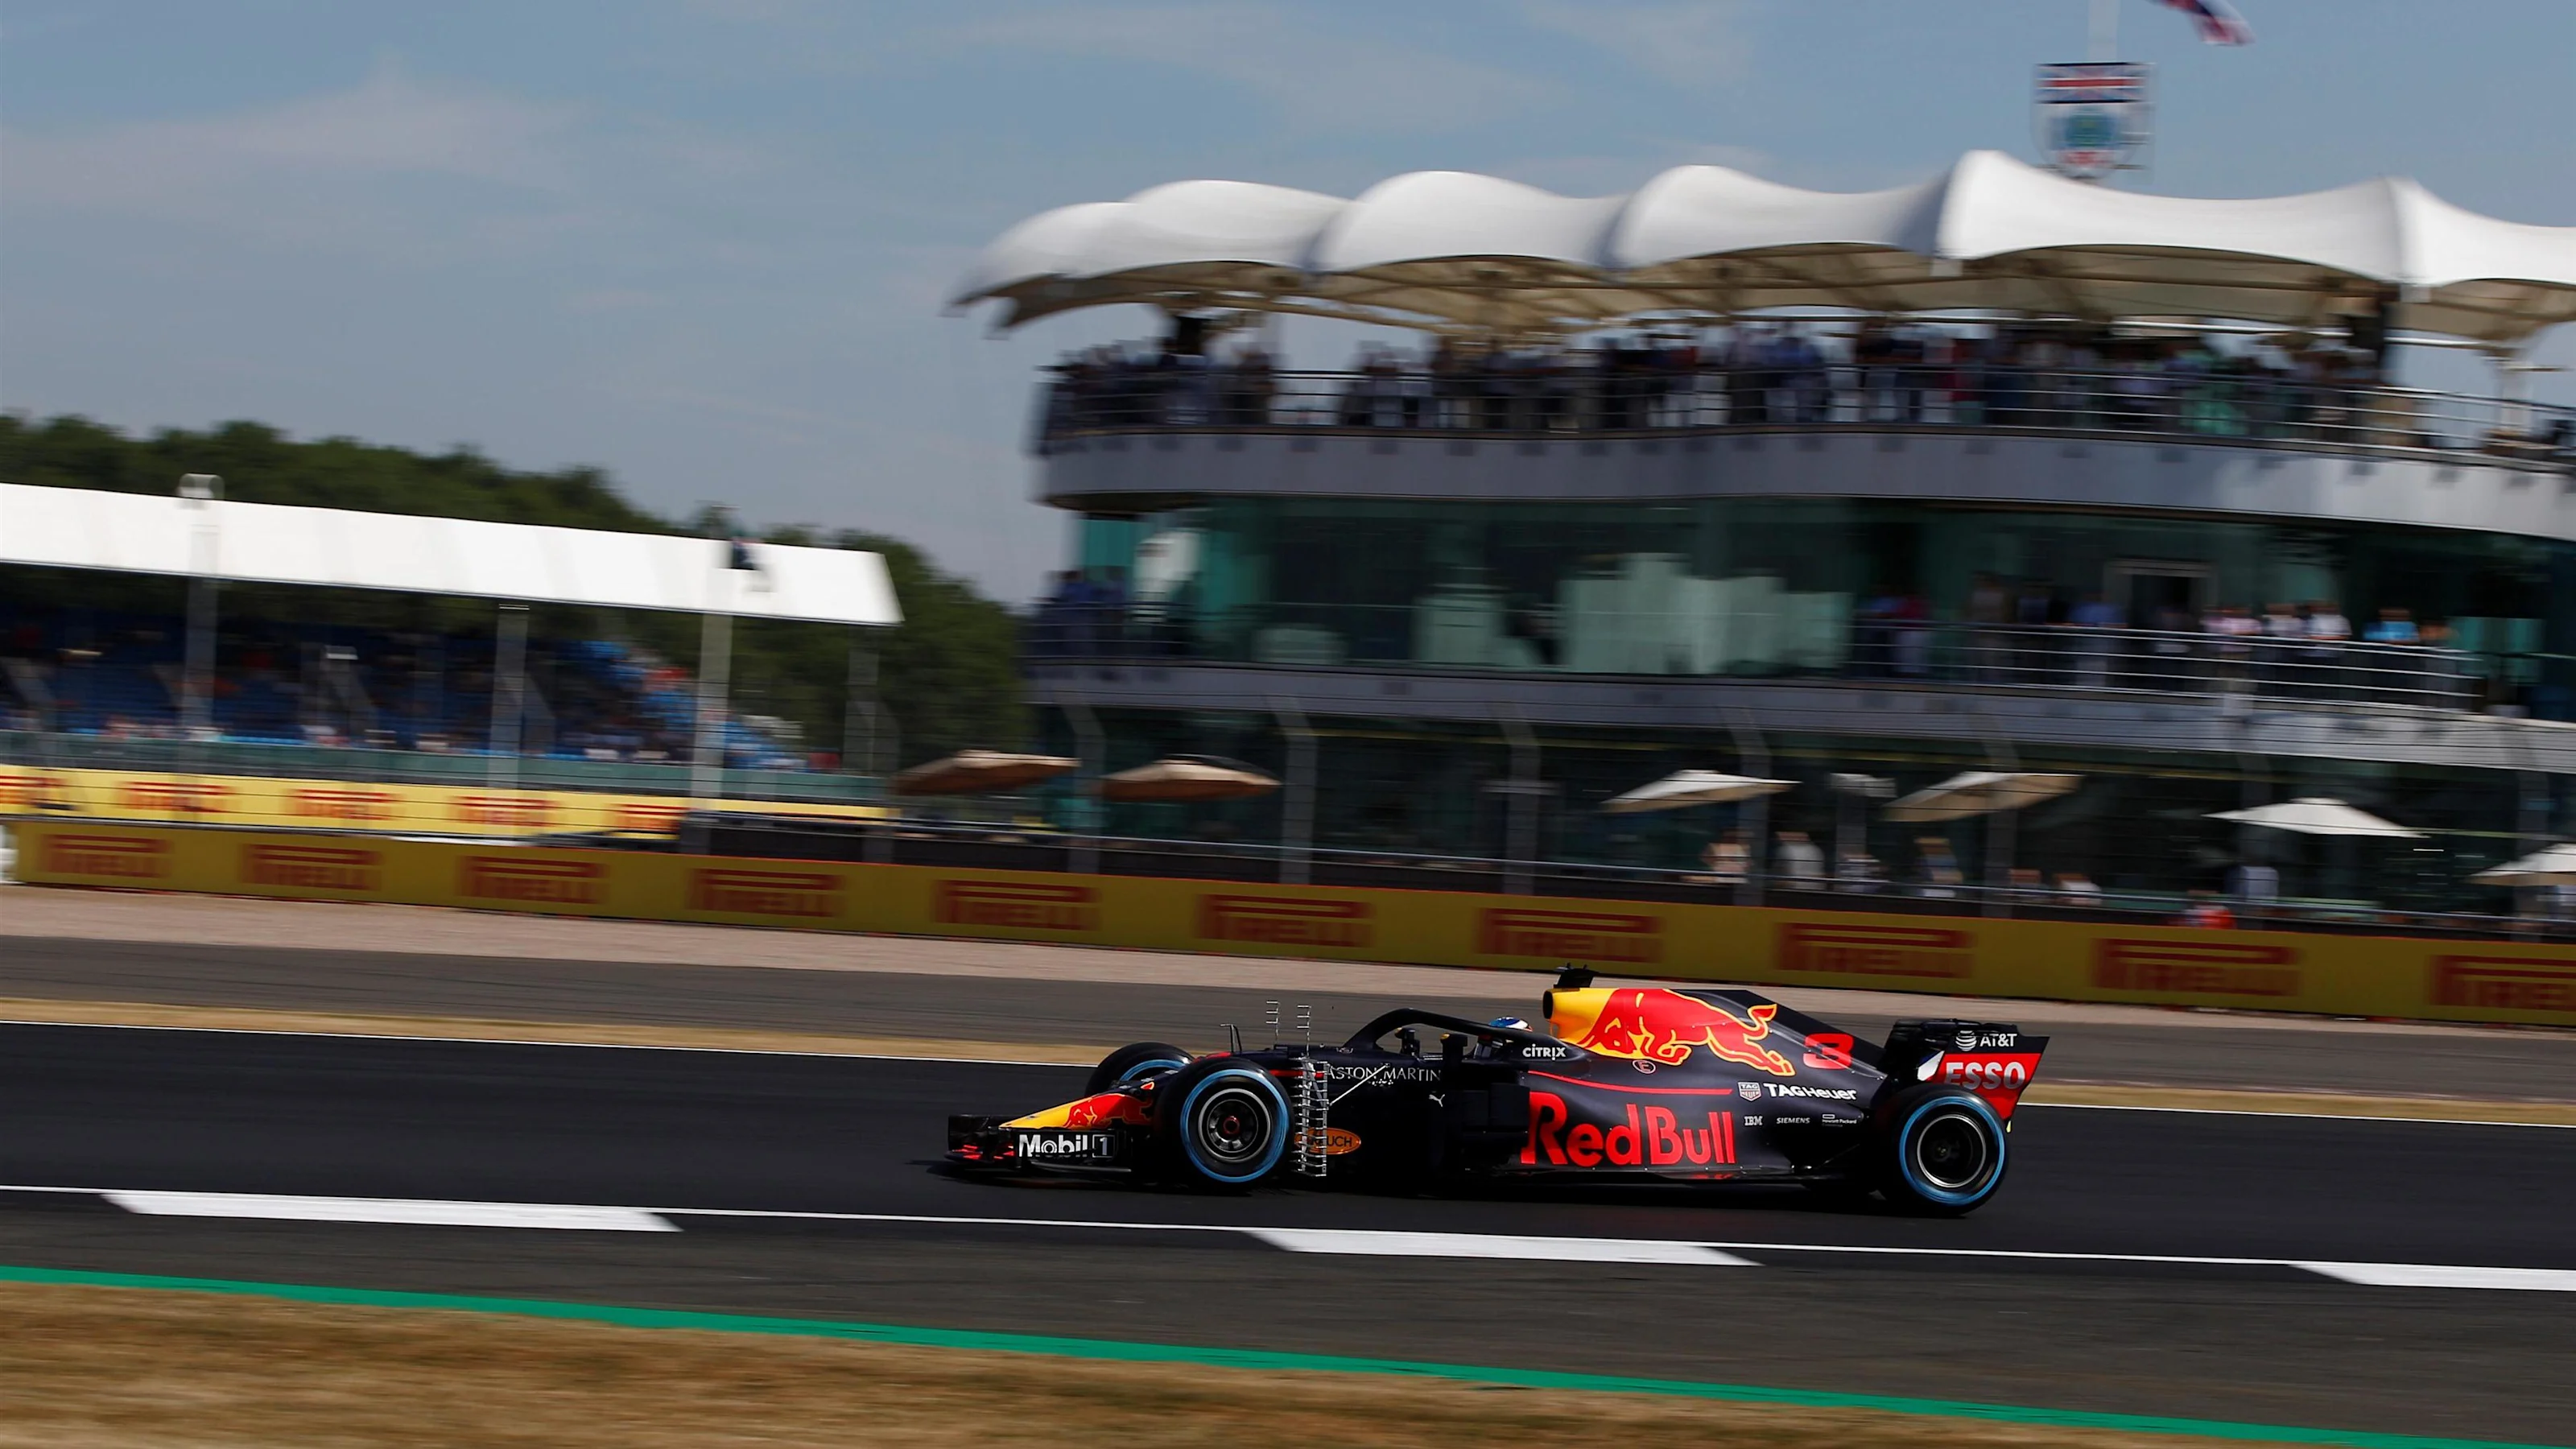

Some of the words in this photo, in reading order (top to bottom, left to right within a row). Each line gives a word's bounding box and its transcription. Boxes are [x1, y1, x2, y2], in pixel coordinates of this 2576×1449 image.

[1979, 1033, 2017, 1047] AT&T
[1802, 1033, 1855, 1070] 3
[1383, 1067, 1441, 1082] MARTIN
[1945, 1061, 2026, 1091] ESSO
[1744, 1116, 1763, 1126] IBM
[1018, 1134, 1088, 1158] Mobil
[1099, 1136, 1108, 1156] 1
